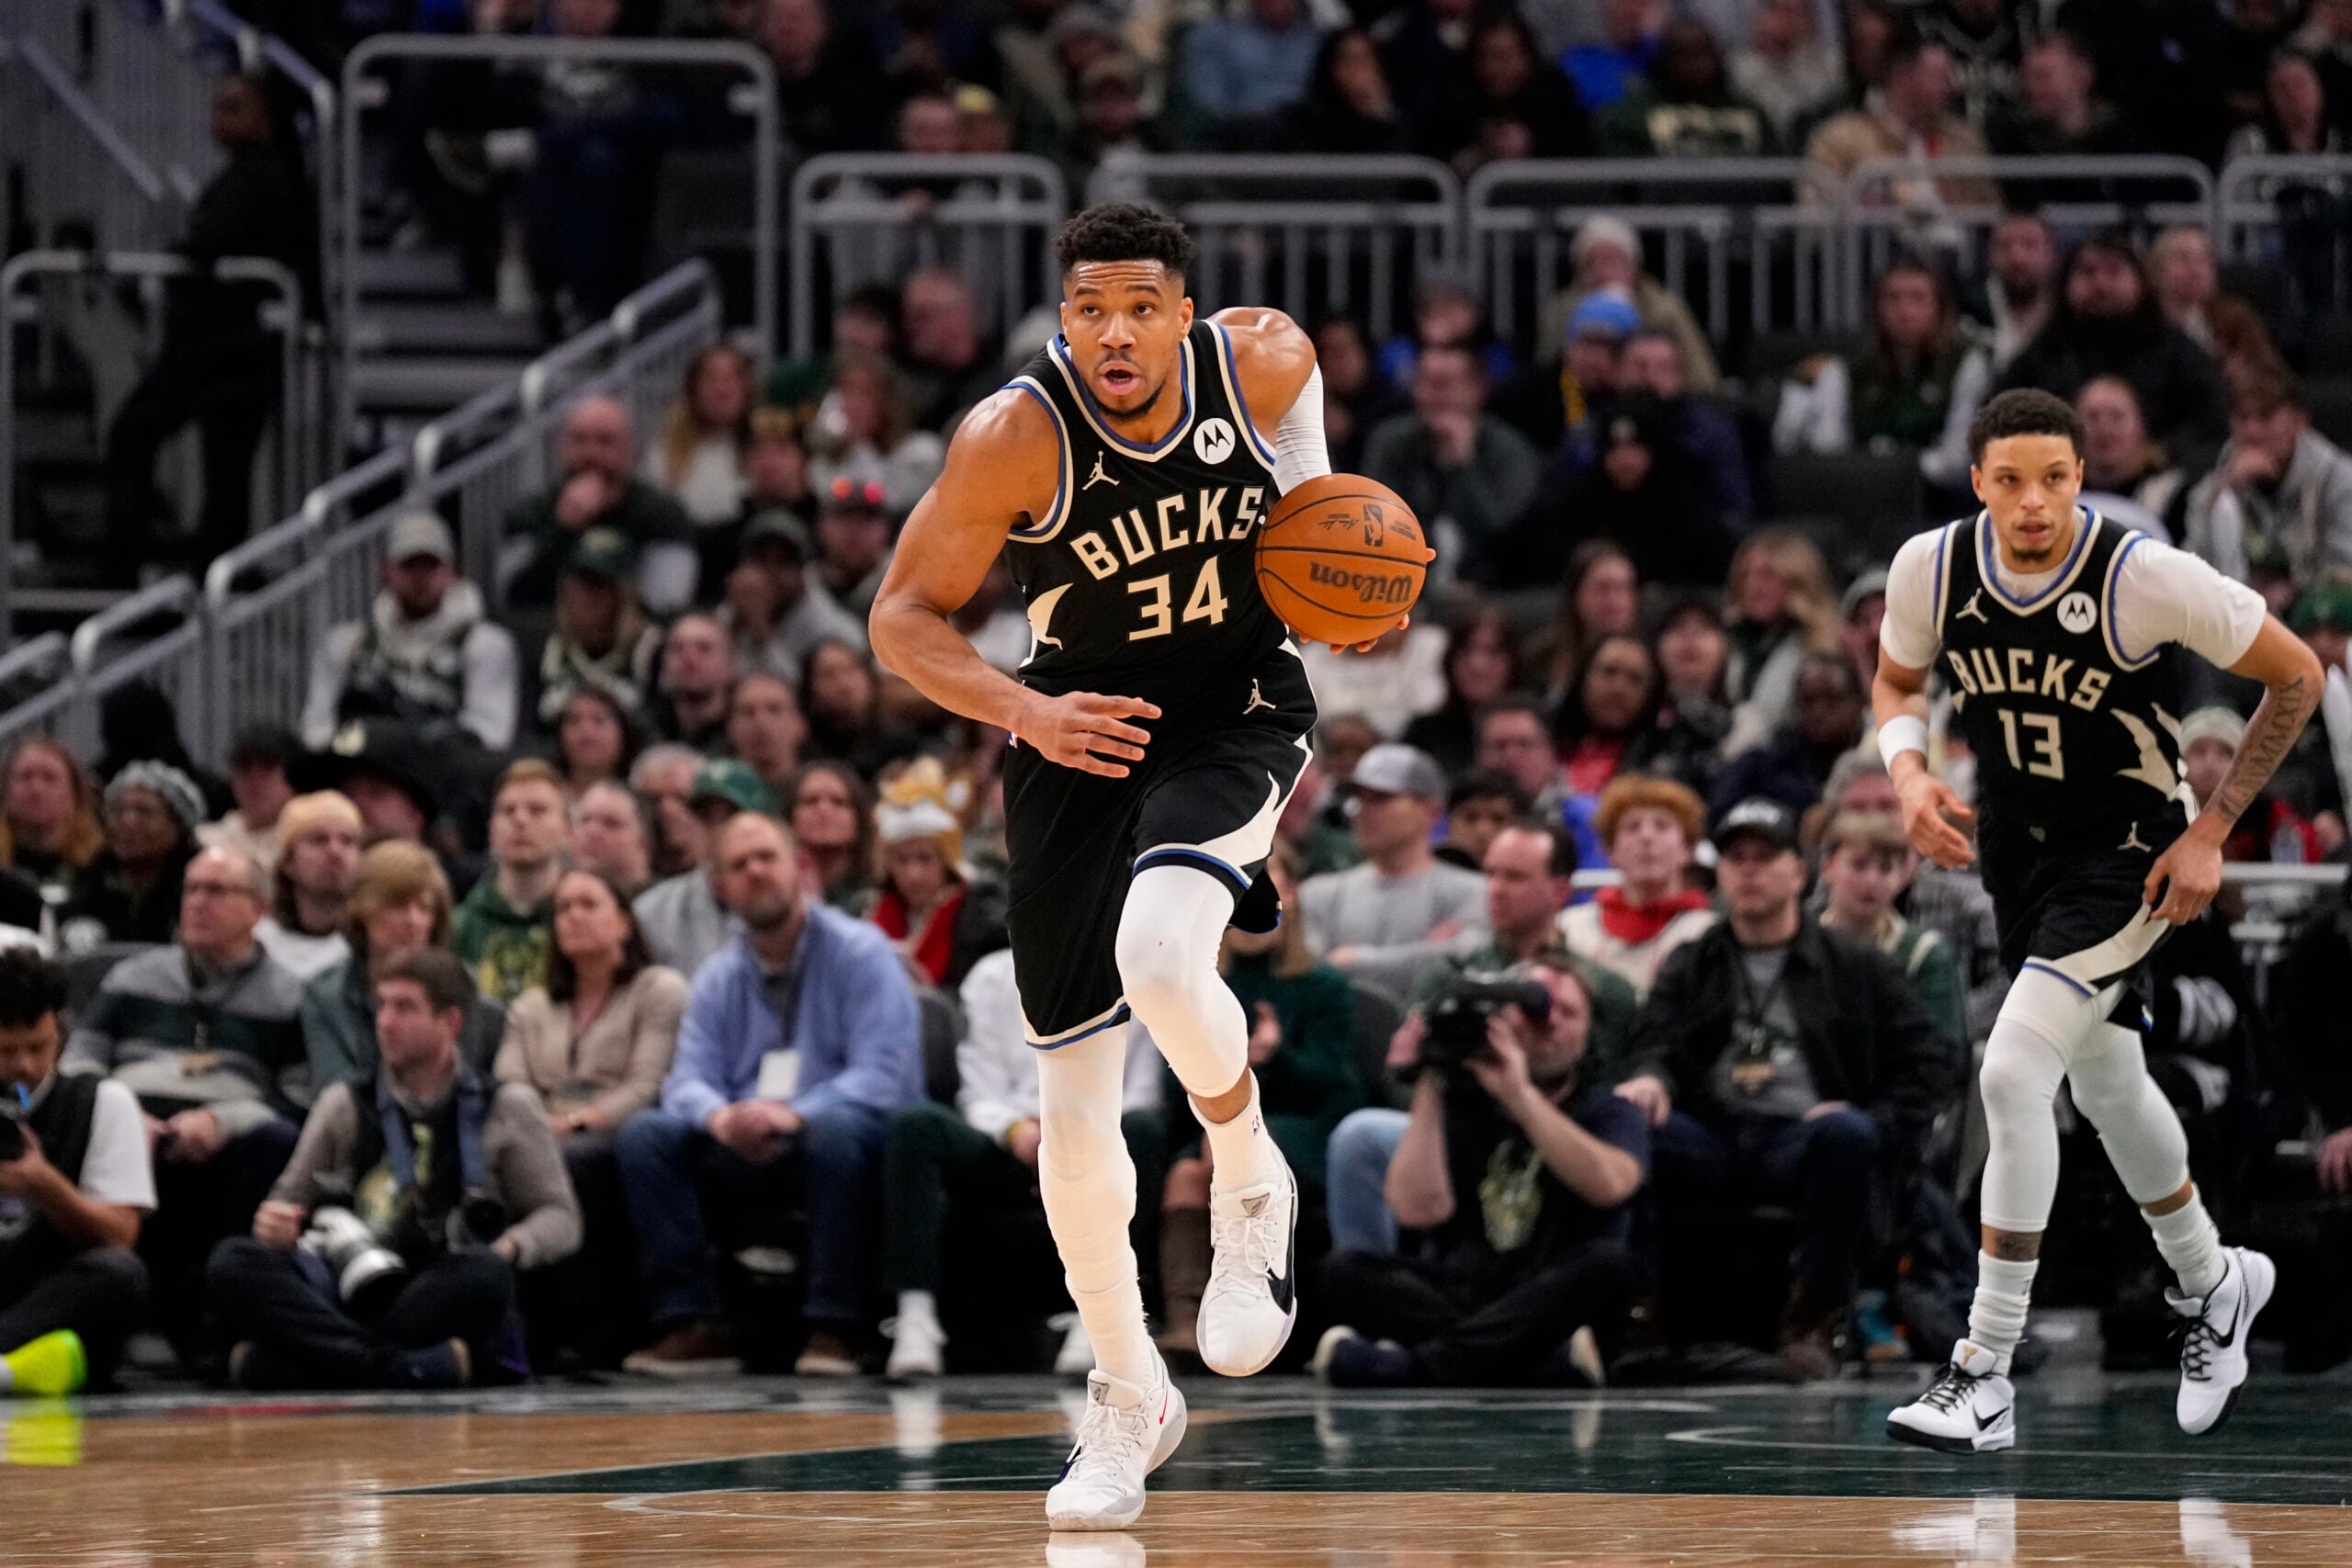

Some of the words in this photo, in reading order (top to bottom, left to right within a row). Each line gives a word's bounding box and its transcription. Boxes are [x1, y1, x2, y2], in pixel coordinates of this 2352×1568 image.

[1069, 487, 1265, 581] BUCKS
[1126, 555, 1228, 641] 34
[1309, 560, 1413, 604] Wilson
[1946, 647, 2112, 713] BUCKS
[1997, 708, 2065, 781] 13
